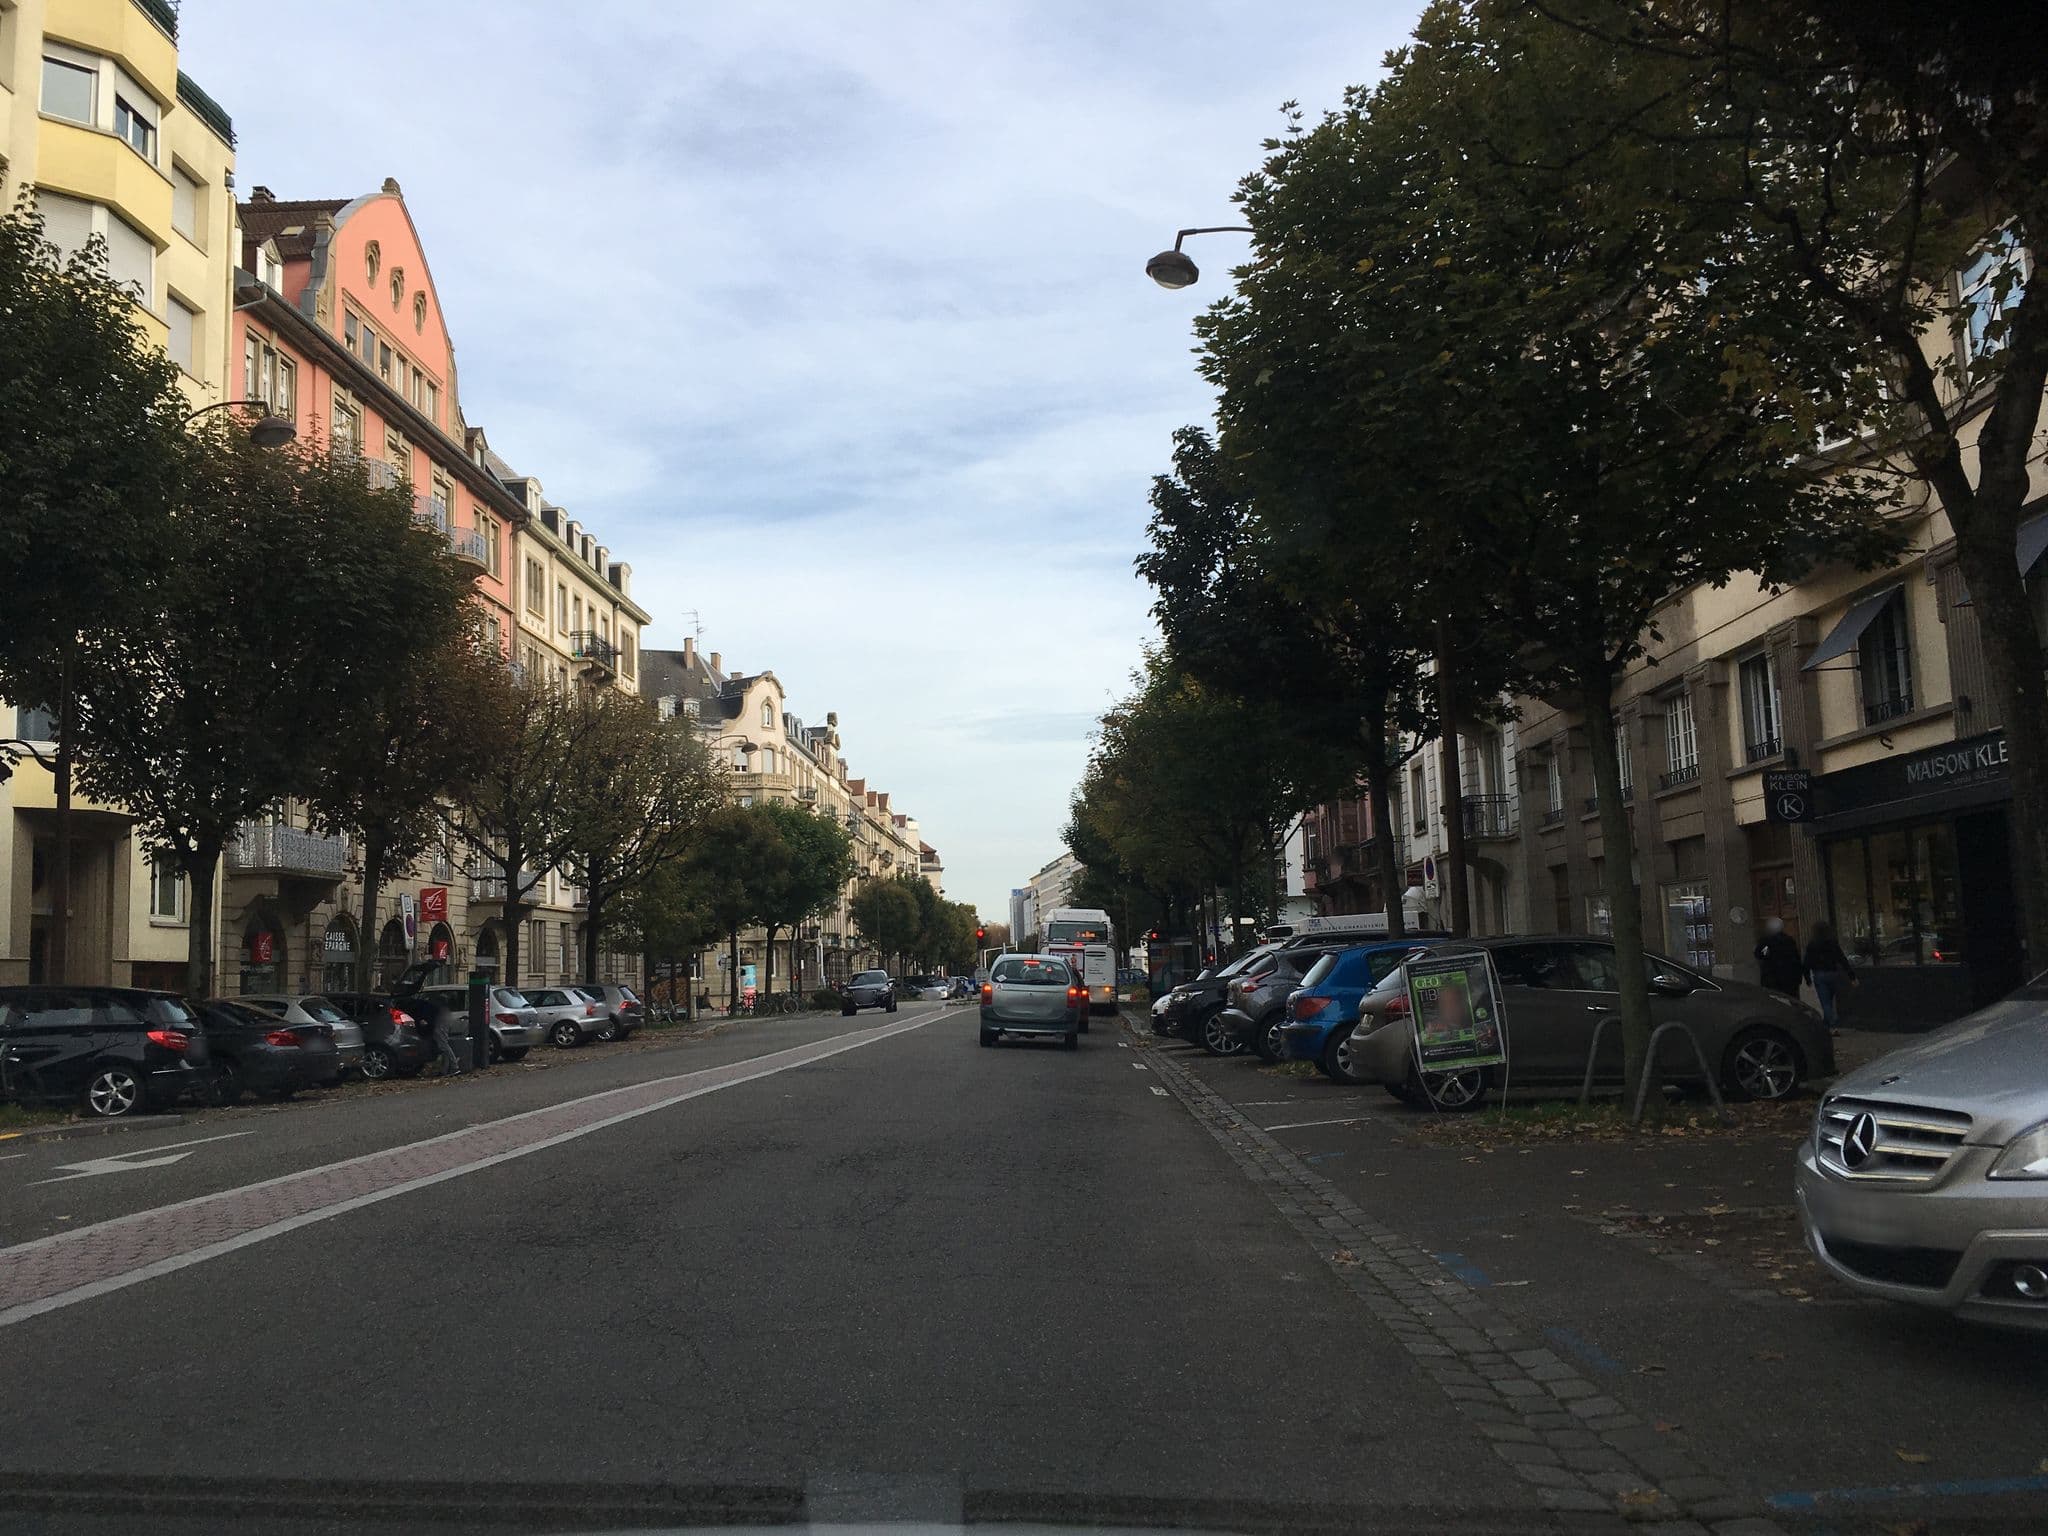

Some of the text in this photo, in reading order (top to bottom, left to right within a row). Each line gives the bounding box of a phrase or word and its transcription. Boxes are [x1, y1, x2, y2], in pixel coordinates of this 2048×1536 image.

[1906, 751, 1970, 784] MAISON
[1976, 740, 2009, 768] KLE
[1769, 773, 1808, 781] MAISON
[1769, 780, 1808, 791] KLEIN
[1783, 798, 1800, 814] K
[326, 932, 345, 941] CAISSE
[325, 941, 350, 951] EPARGNE
[1415, 976, 1439, 989] GEO
[1420, 988, 1441, 1002] TIB
